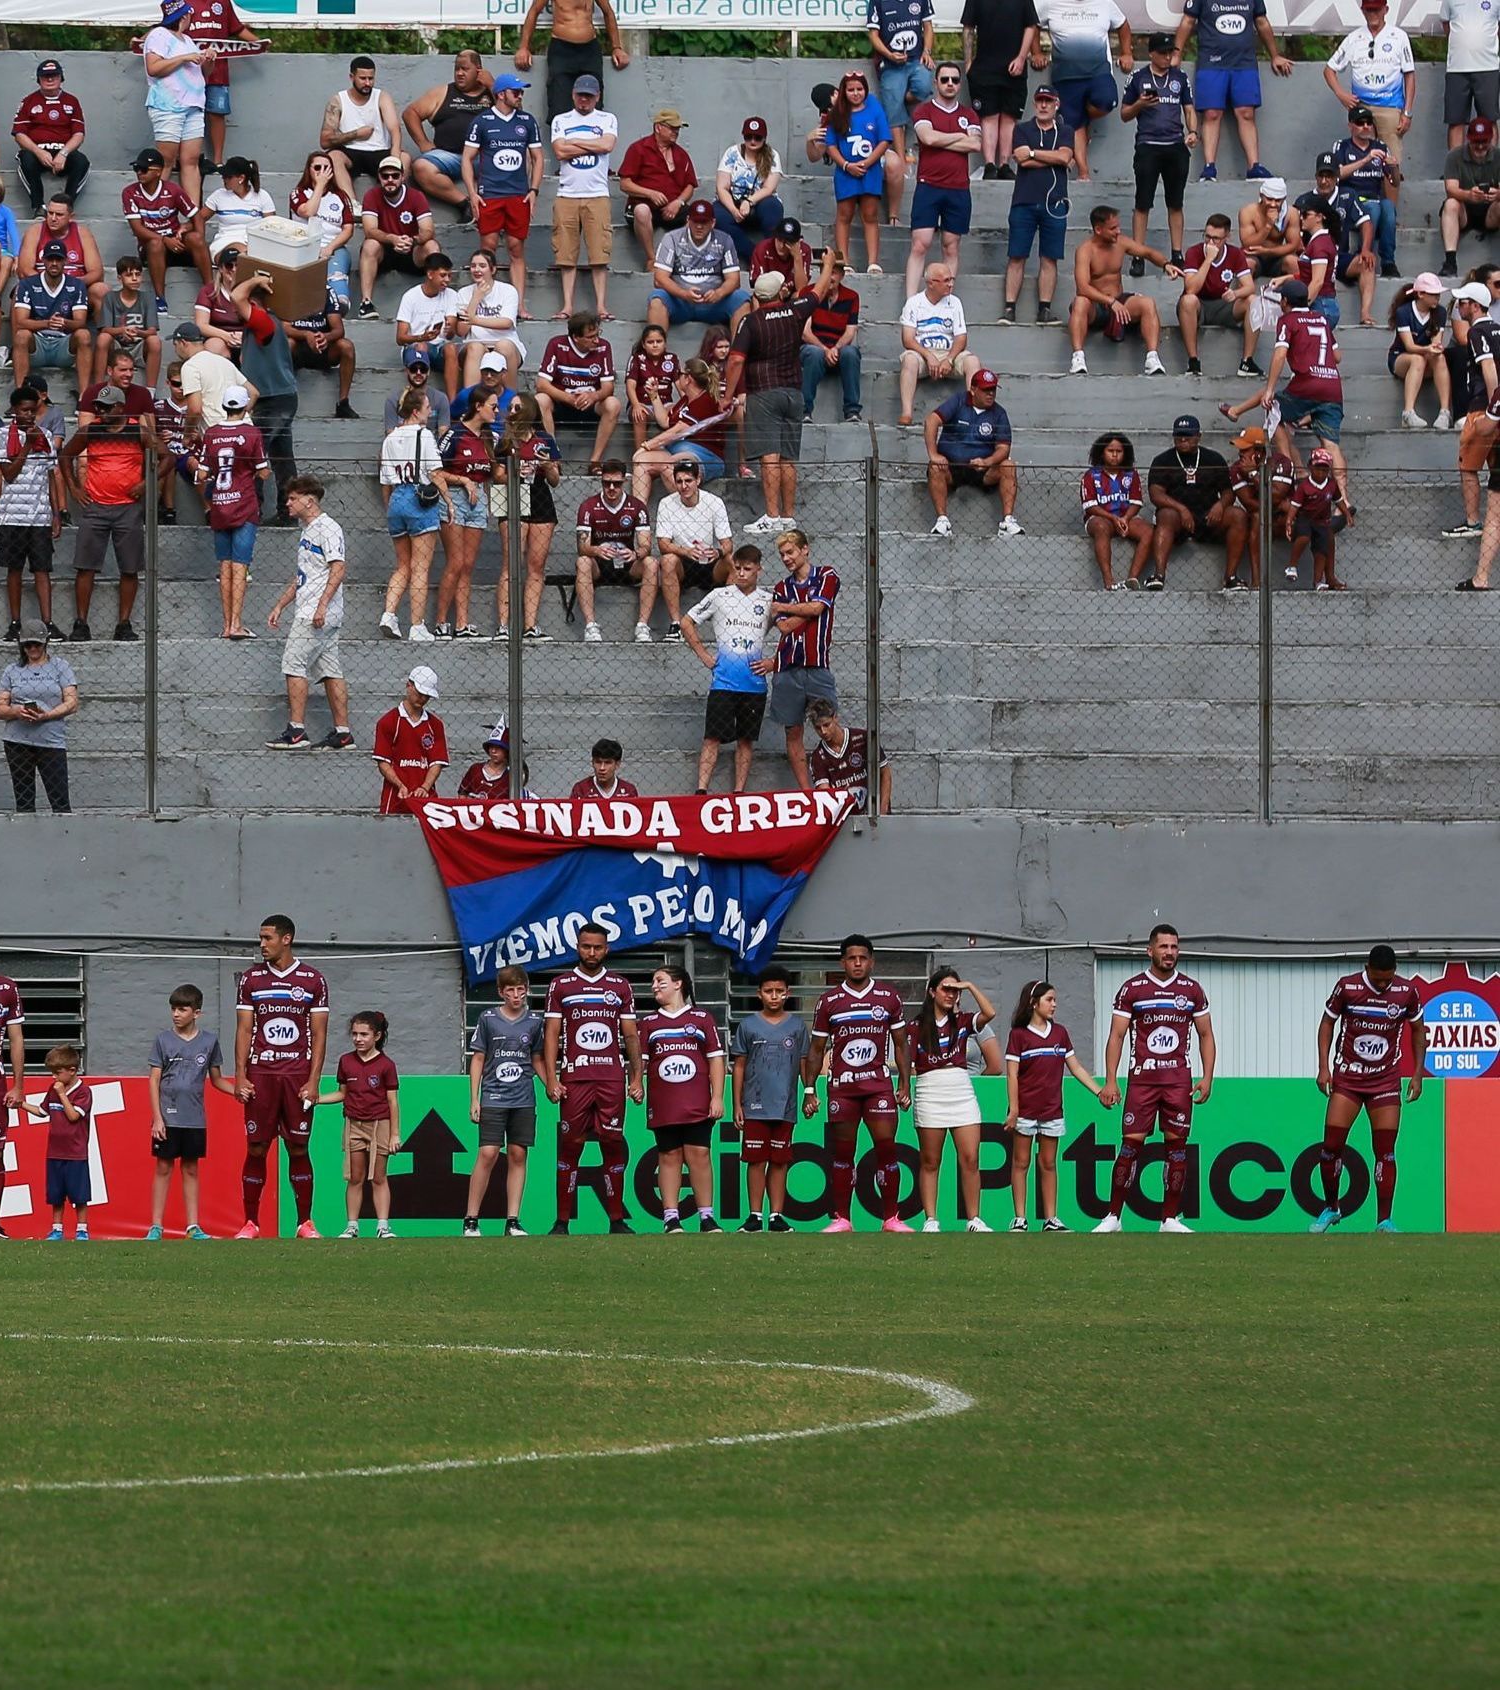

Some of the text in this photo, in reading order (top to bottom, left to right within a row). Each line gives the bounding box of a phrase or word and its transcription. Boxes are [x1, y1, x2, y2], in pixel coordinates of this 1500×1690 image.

[743, 0, 869, 22] diferença
[1220, 19, 1243, 30] SIM
[498, 155, 520, 166] SIM
[732, 637, 755, 650] SIM
[422, 800, 681, 838] SUSINADA
[469, 905, 622, 976] VIEMOS
[1440, 1003, 1476, 1018] S.E.R.
[266, 1025, 294, 1040] SIM
[581, 1029, 608, 1045] SIM
[663, 1042, 698, 1052] banrisul
[1150, 1033, 1175, 1048] SIM
[1359, 1040, 1387, 1056] SIM
[846, 1045, 873, 1061] SIM
[664, 1062, 691, 1076] SIM
[1435, 1054, 1481, 1070] DO SUL
[500, 1066, 520, 1078] SIM
